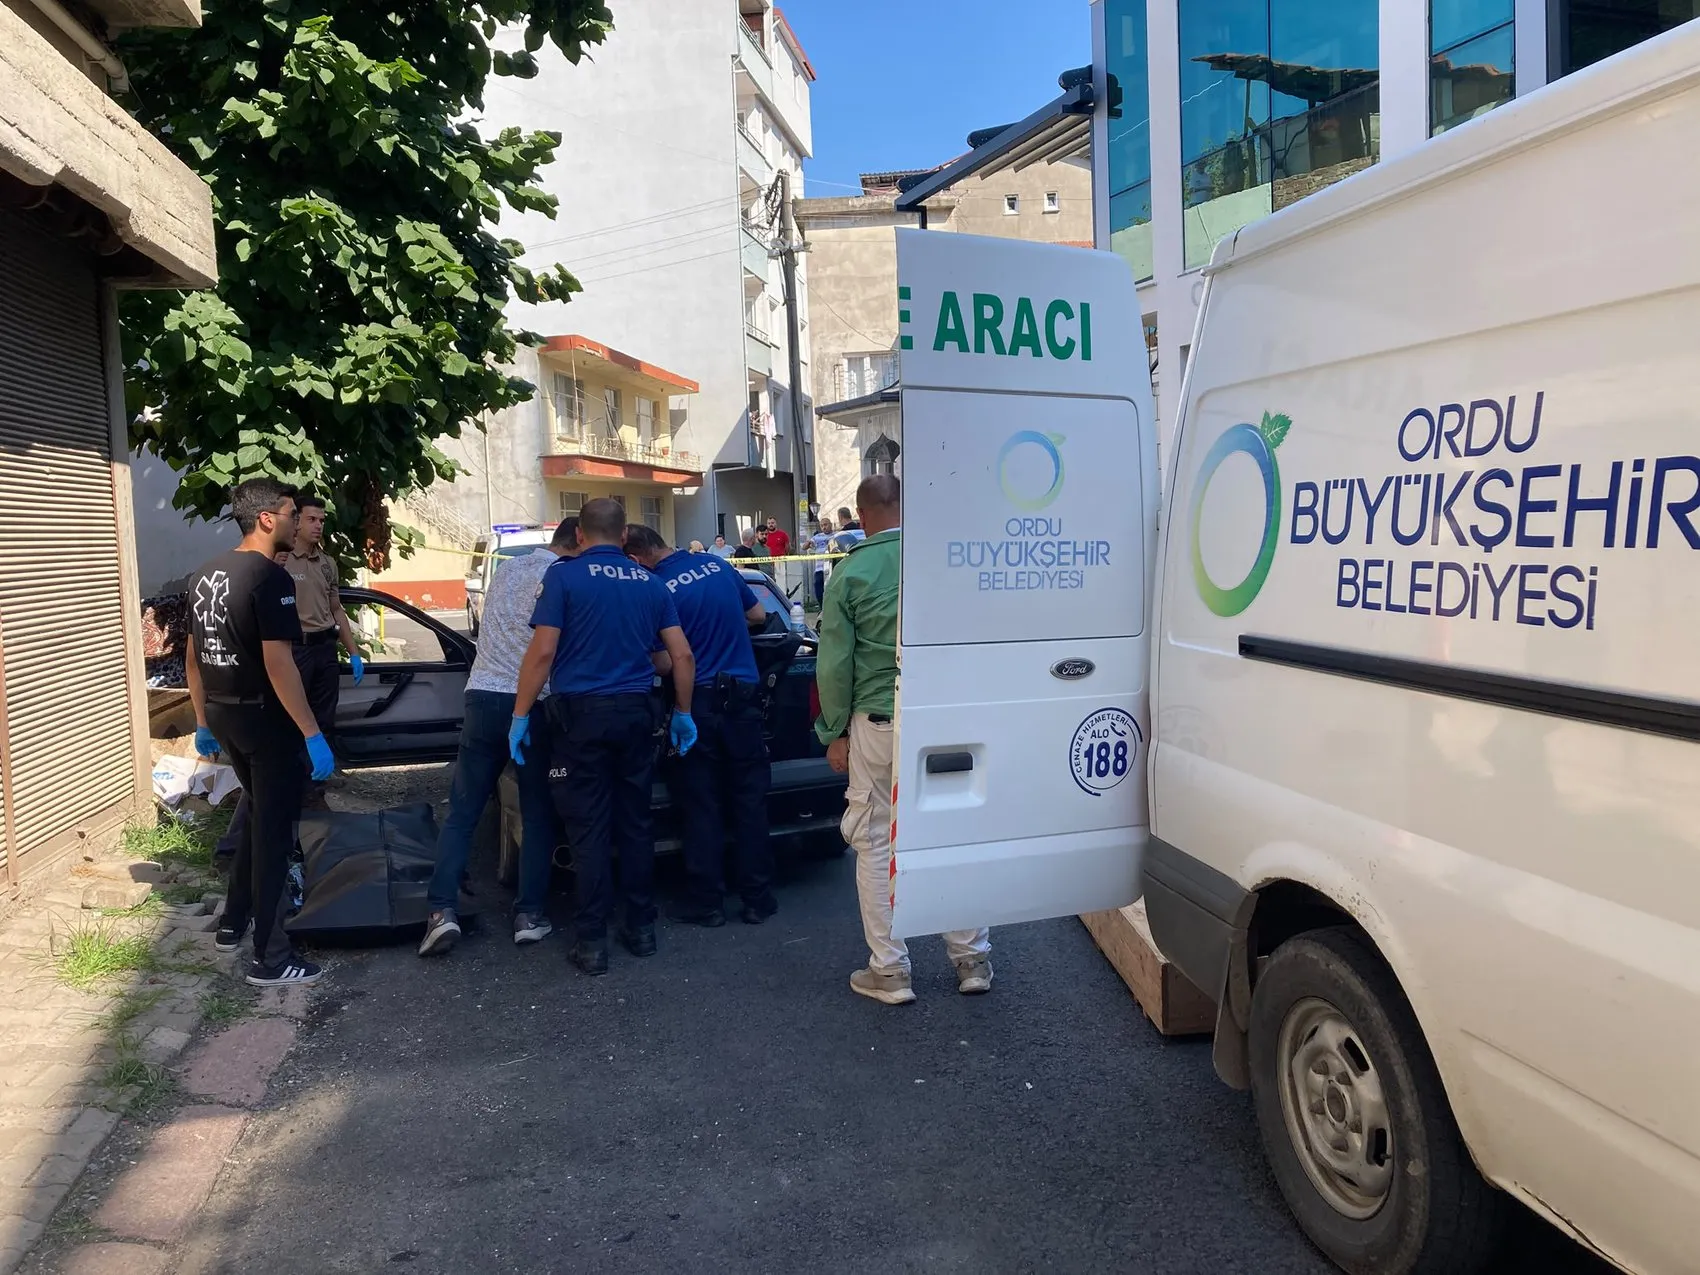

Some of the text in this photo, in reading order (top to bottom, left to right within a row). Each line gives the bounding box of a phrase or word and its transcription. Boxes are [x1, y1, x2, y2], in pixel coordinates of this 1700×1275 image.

[932, 291, 1092, 361] ARACI
[1398, 391, 1544, 463] ORDU
[1005, 518, 1062, 537] ORDU
[1062, 662, 1088, 675] Ford
[1090, 728, 1109, 739] ALO
[1074, 735, 1084, 773] CENAZE
[1084, 740, 1128, 778] 188
